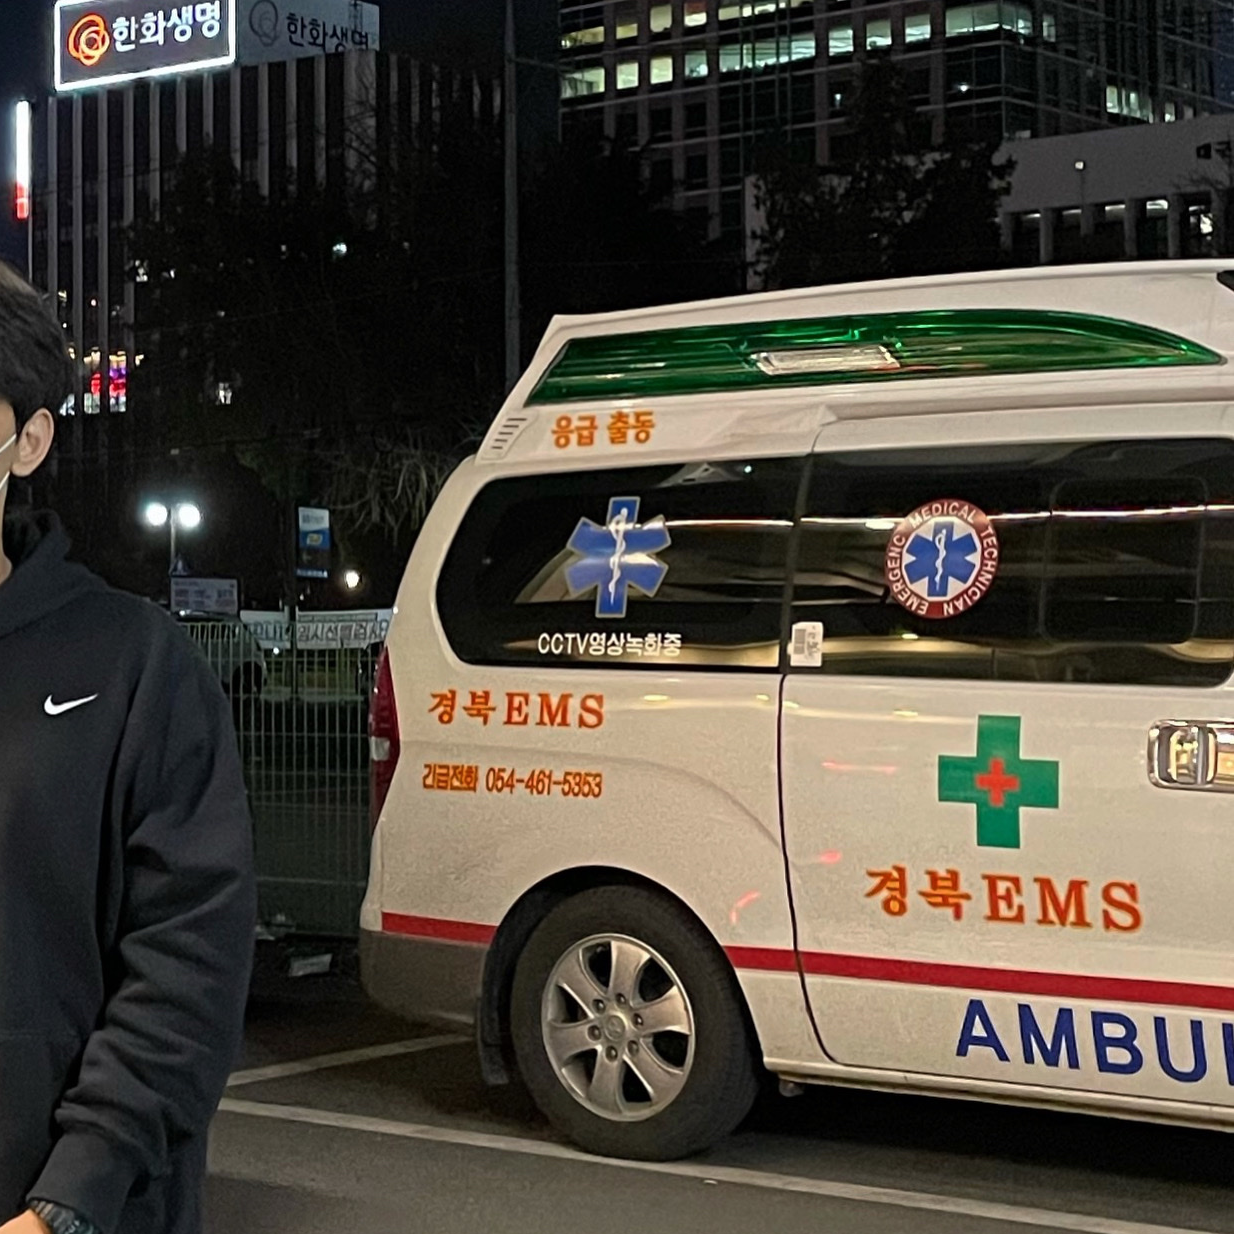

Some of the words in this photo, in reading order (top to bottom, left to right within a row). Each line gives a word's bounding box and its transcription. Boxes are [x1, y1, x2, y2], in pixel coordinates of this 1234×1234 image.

[112, 1, 221, 52] 한화생명
[551, 415, 598, 448] 응급
[607, 411, 655, 444] 출동
[908, 502, 976, 528] MEDICAL
[943, 525, 998, 616] TECHNICIAN
[537, 632, 682, 657] CCTV영상녹화중
[422, 763, 479, 792] 긴급전화
[485, 766, 603, 798] 054-461-5353
